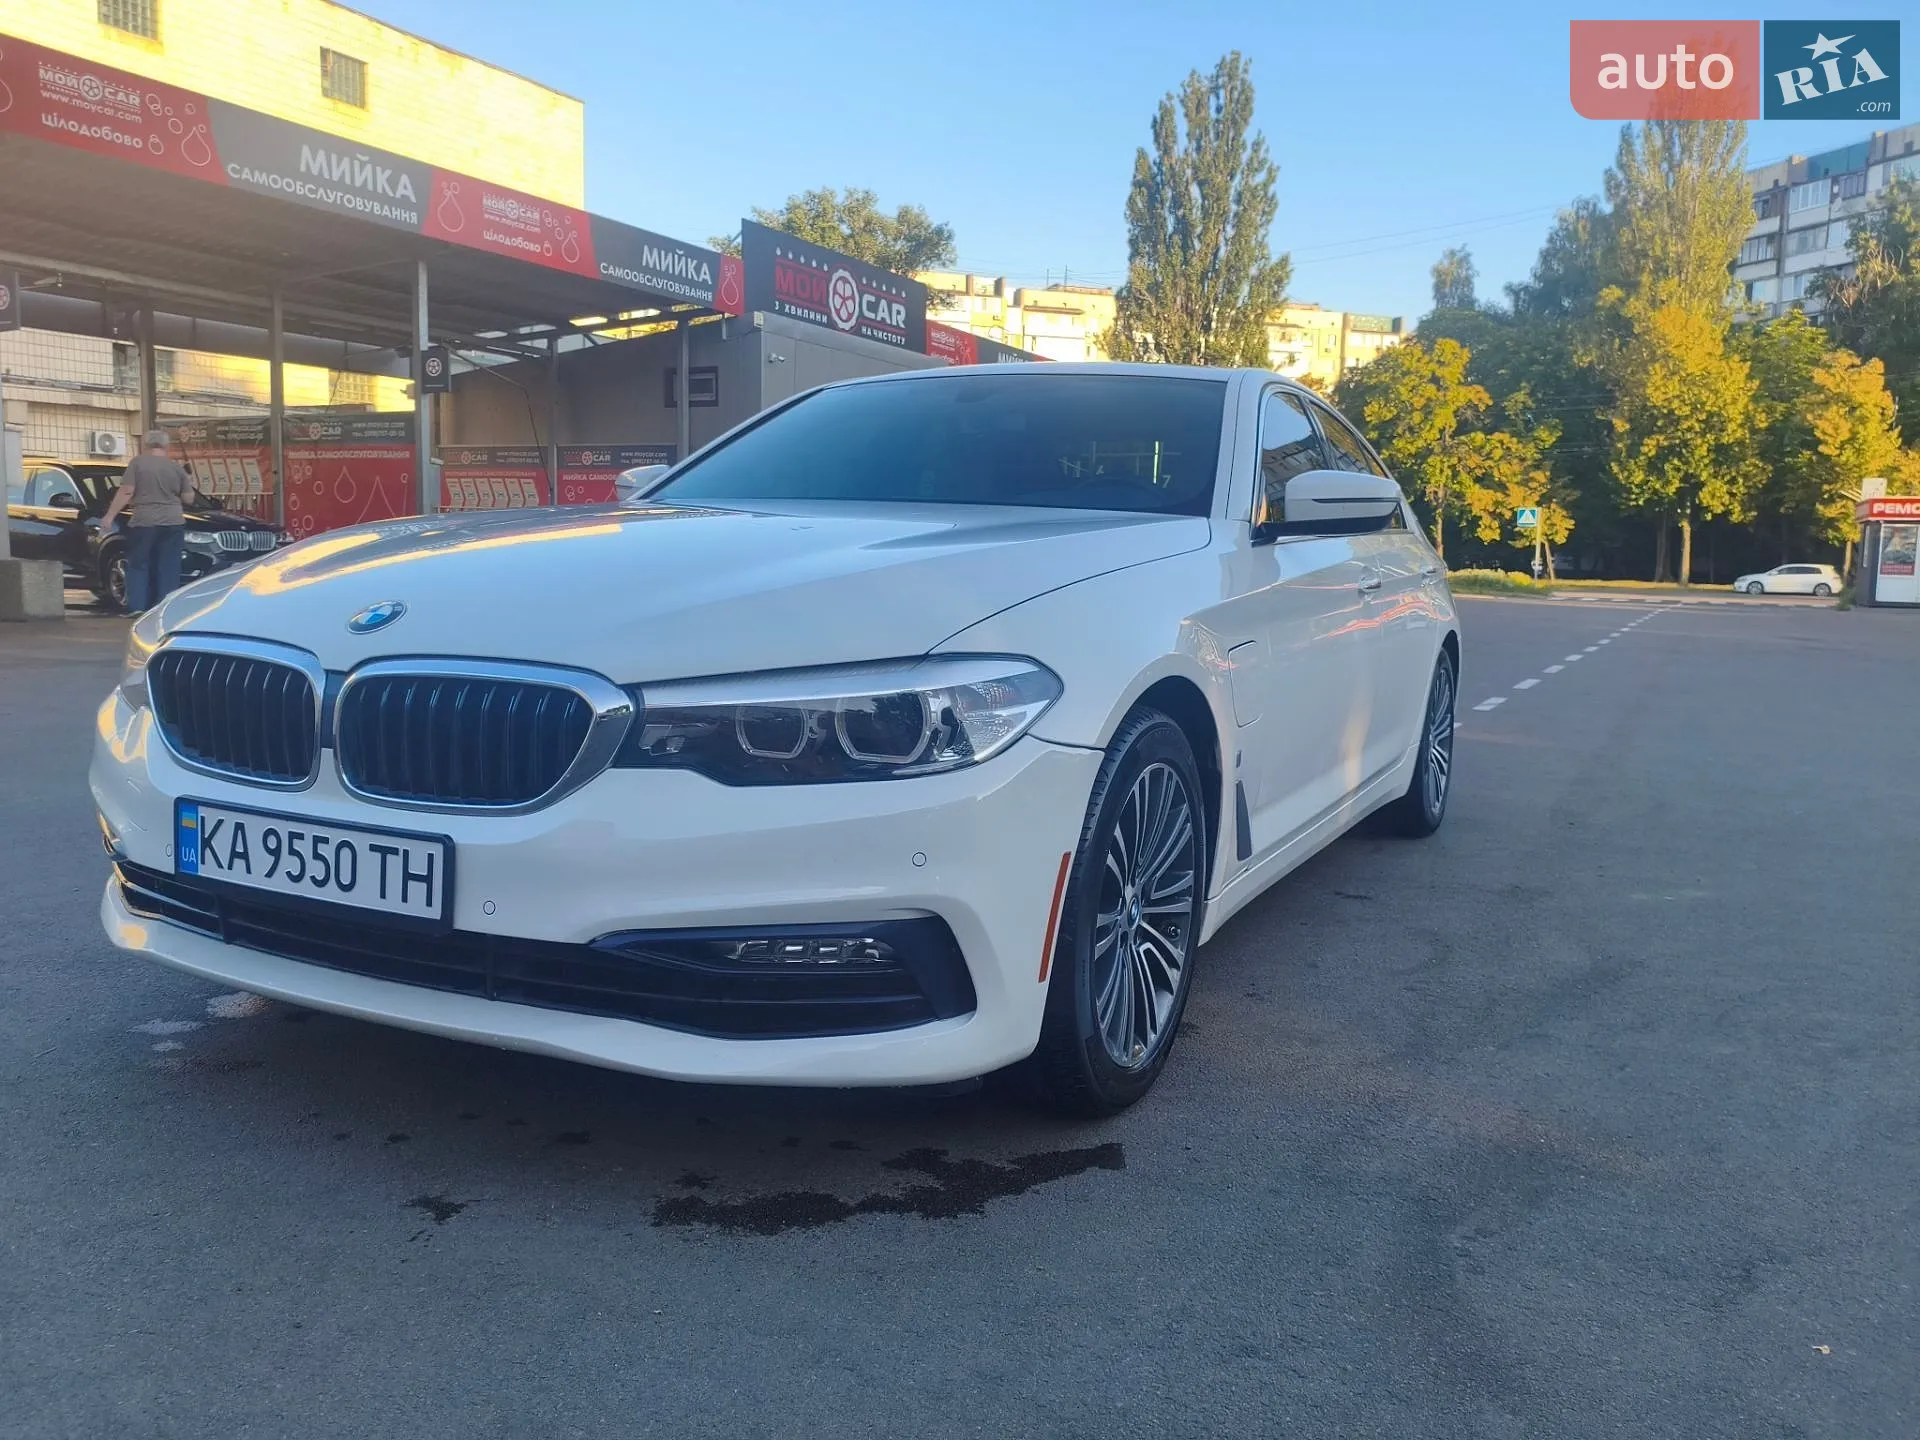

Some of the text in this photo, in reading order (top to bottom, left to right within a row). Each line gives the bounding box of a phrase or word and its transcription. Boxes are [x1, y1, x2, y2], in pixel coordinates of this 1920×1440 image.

[103, 86, 141, 107] CAR
[300, 144, 417, 204] МИЙКА
[227, 163, 418, 225] САМООБСЛУГОВУВАННЯ
[600, 262, 713, 302] САМООБСЛУГОВУВАННЯ
[641, 244, 712, 285] МИЙКА
[784, 303, 828, 325] ХВИЛИНИ
[862, 293, 906, 328] CAR
[873, 329, 905, 345] ЧИСТОТУ
[593, 454, 611, 462] CAR
[181, 850, 197, 864] UA
[199, 815, 437, 908] KA 9550 TH
